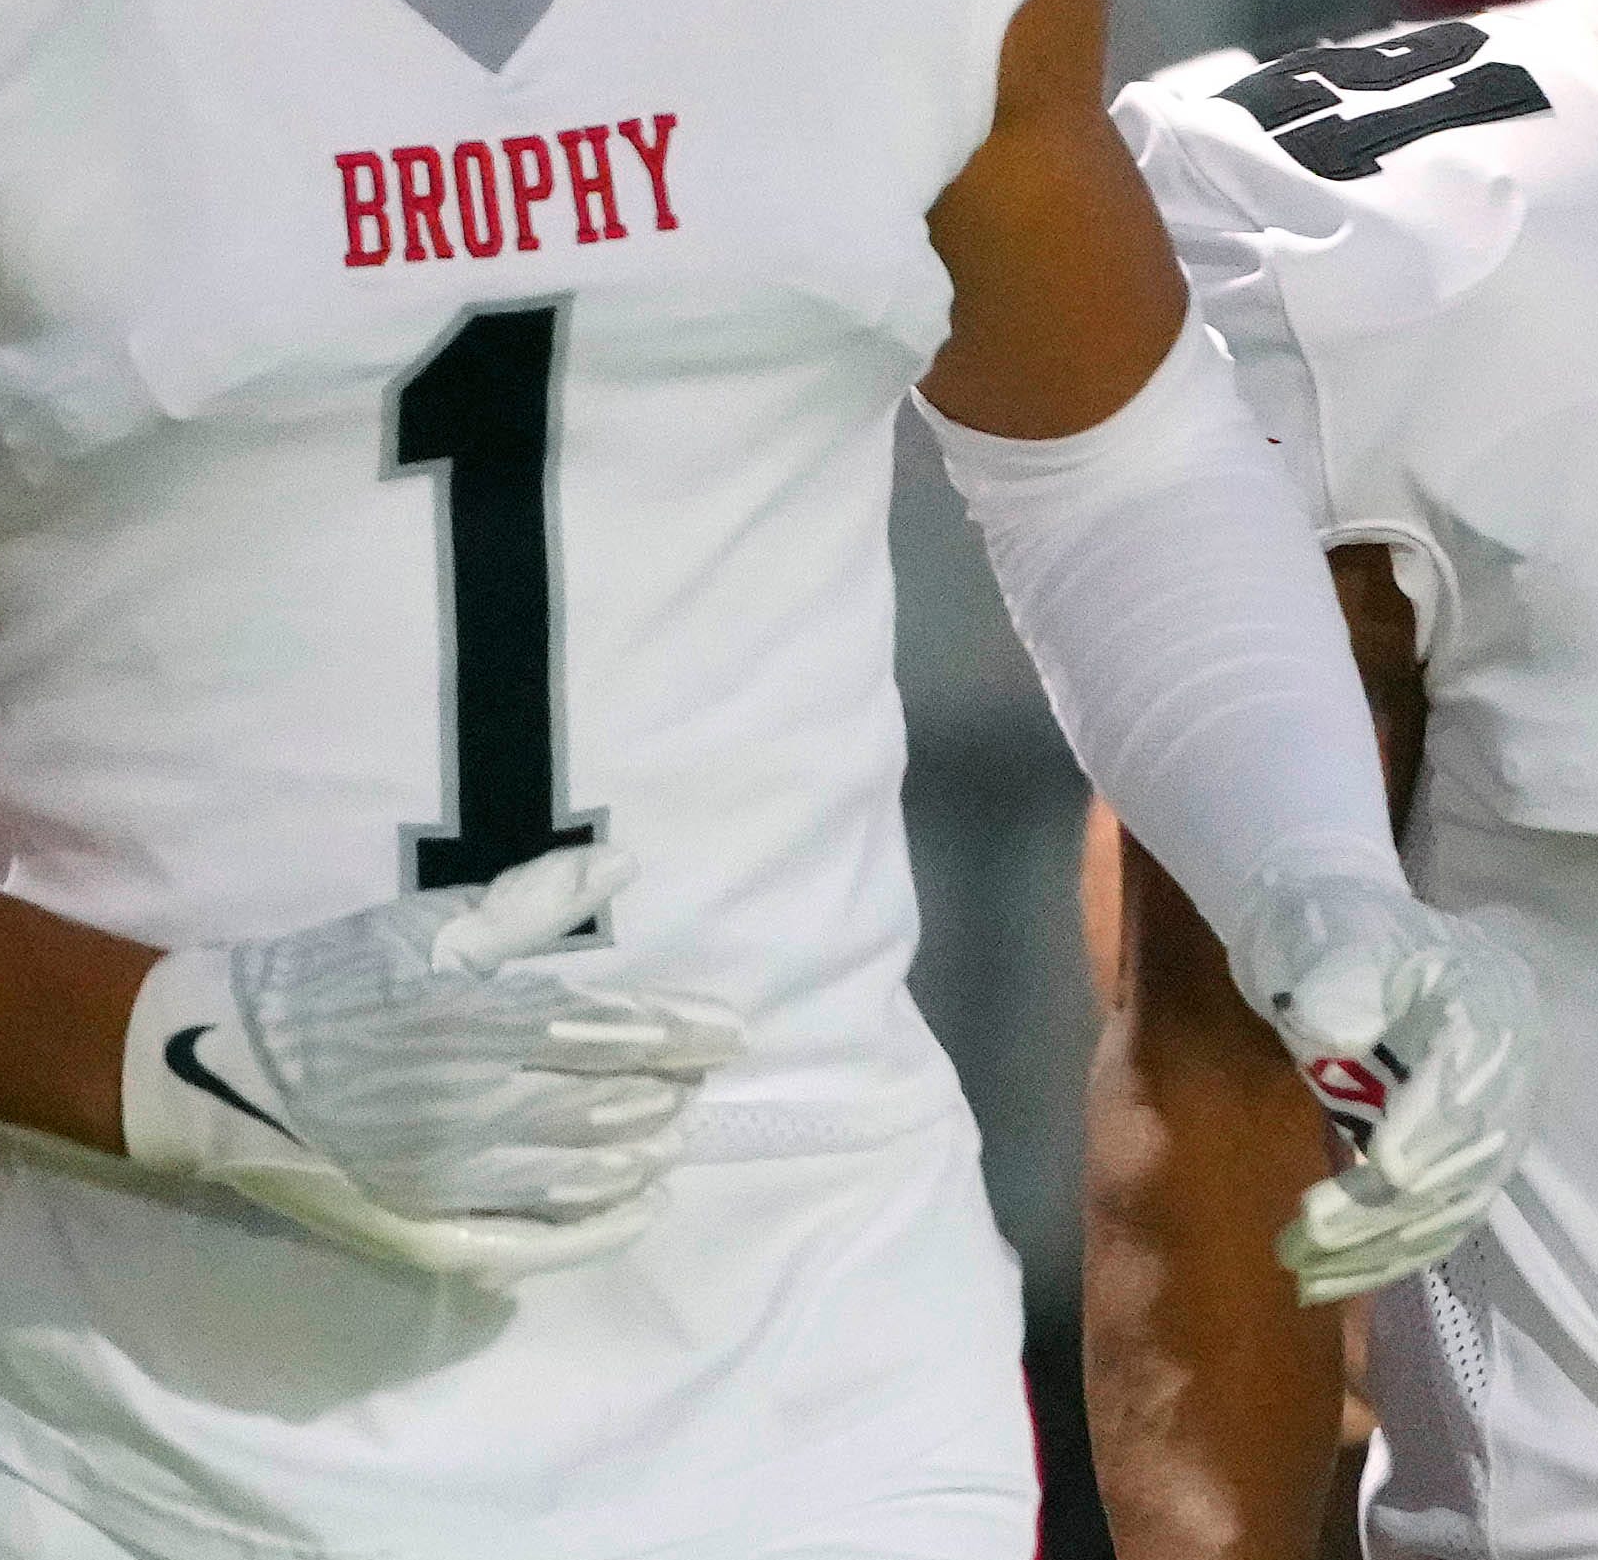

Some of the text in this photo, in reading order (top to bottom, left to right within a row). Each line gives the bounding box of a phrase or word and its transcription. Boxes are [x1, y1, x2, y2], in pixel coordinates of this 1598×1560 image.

[1207, 21, 1552, 181] 21
[335, 113, 680, 267] BROPHY
[381, 291, 611, 945] 1
